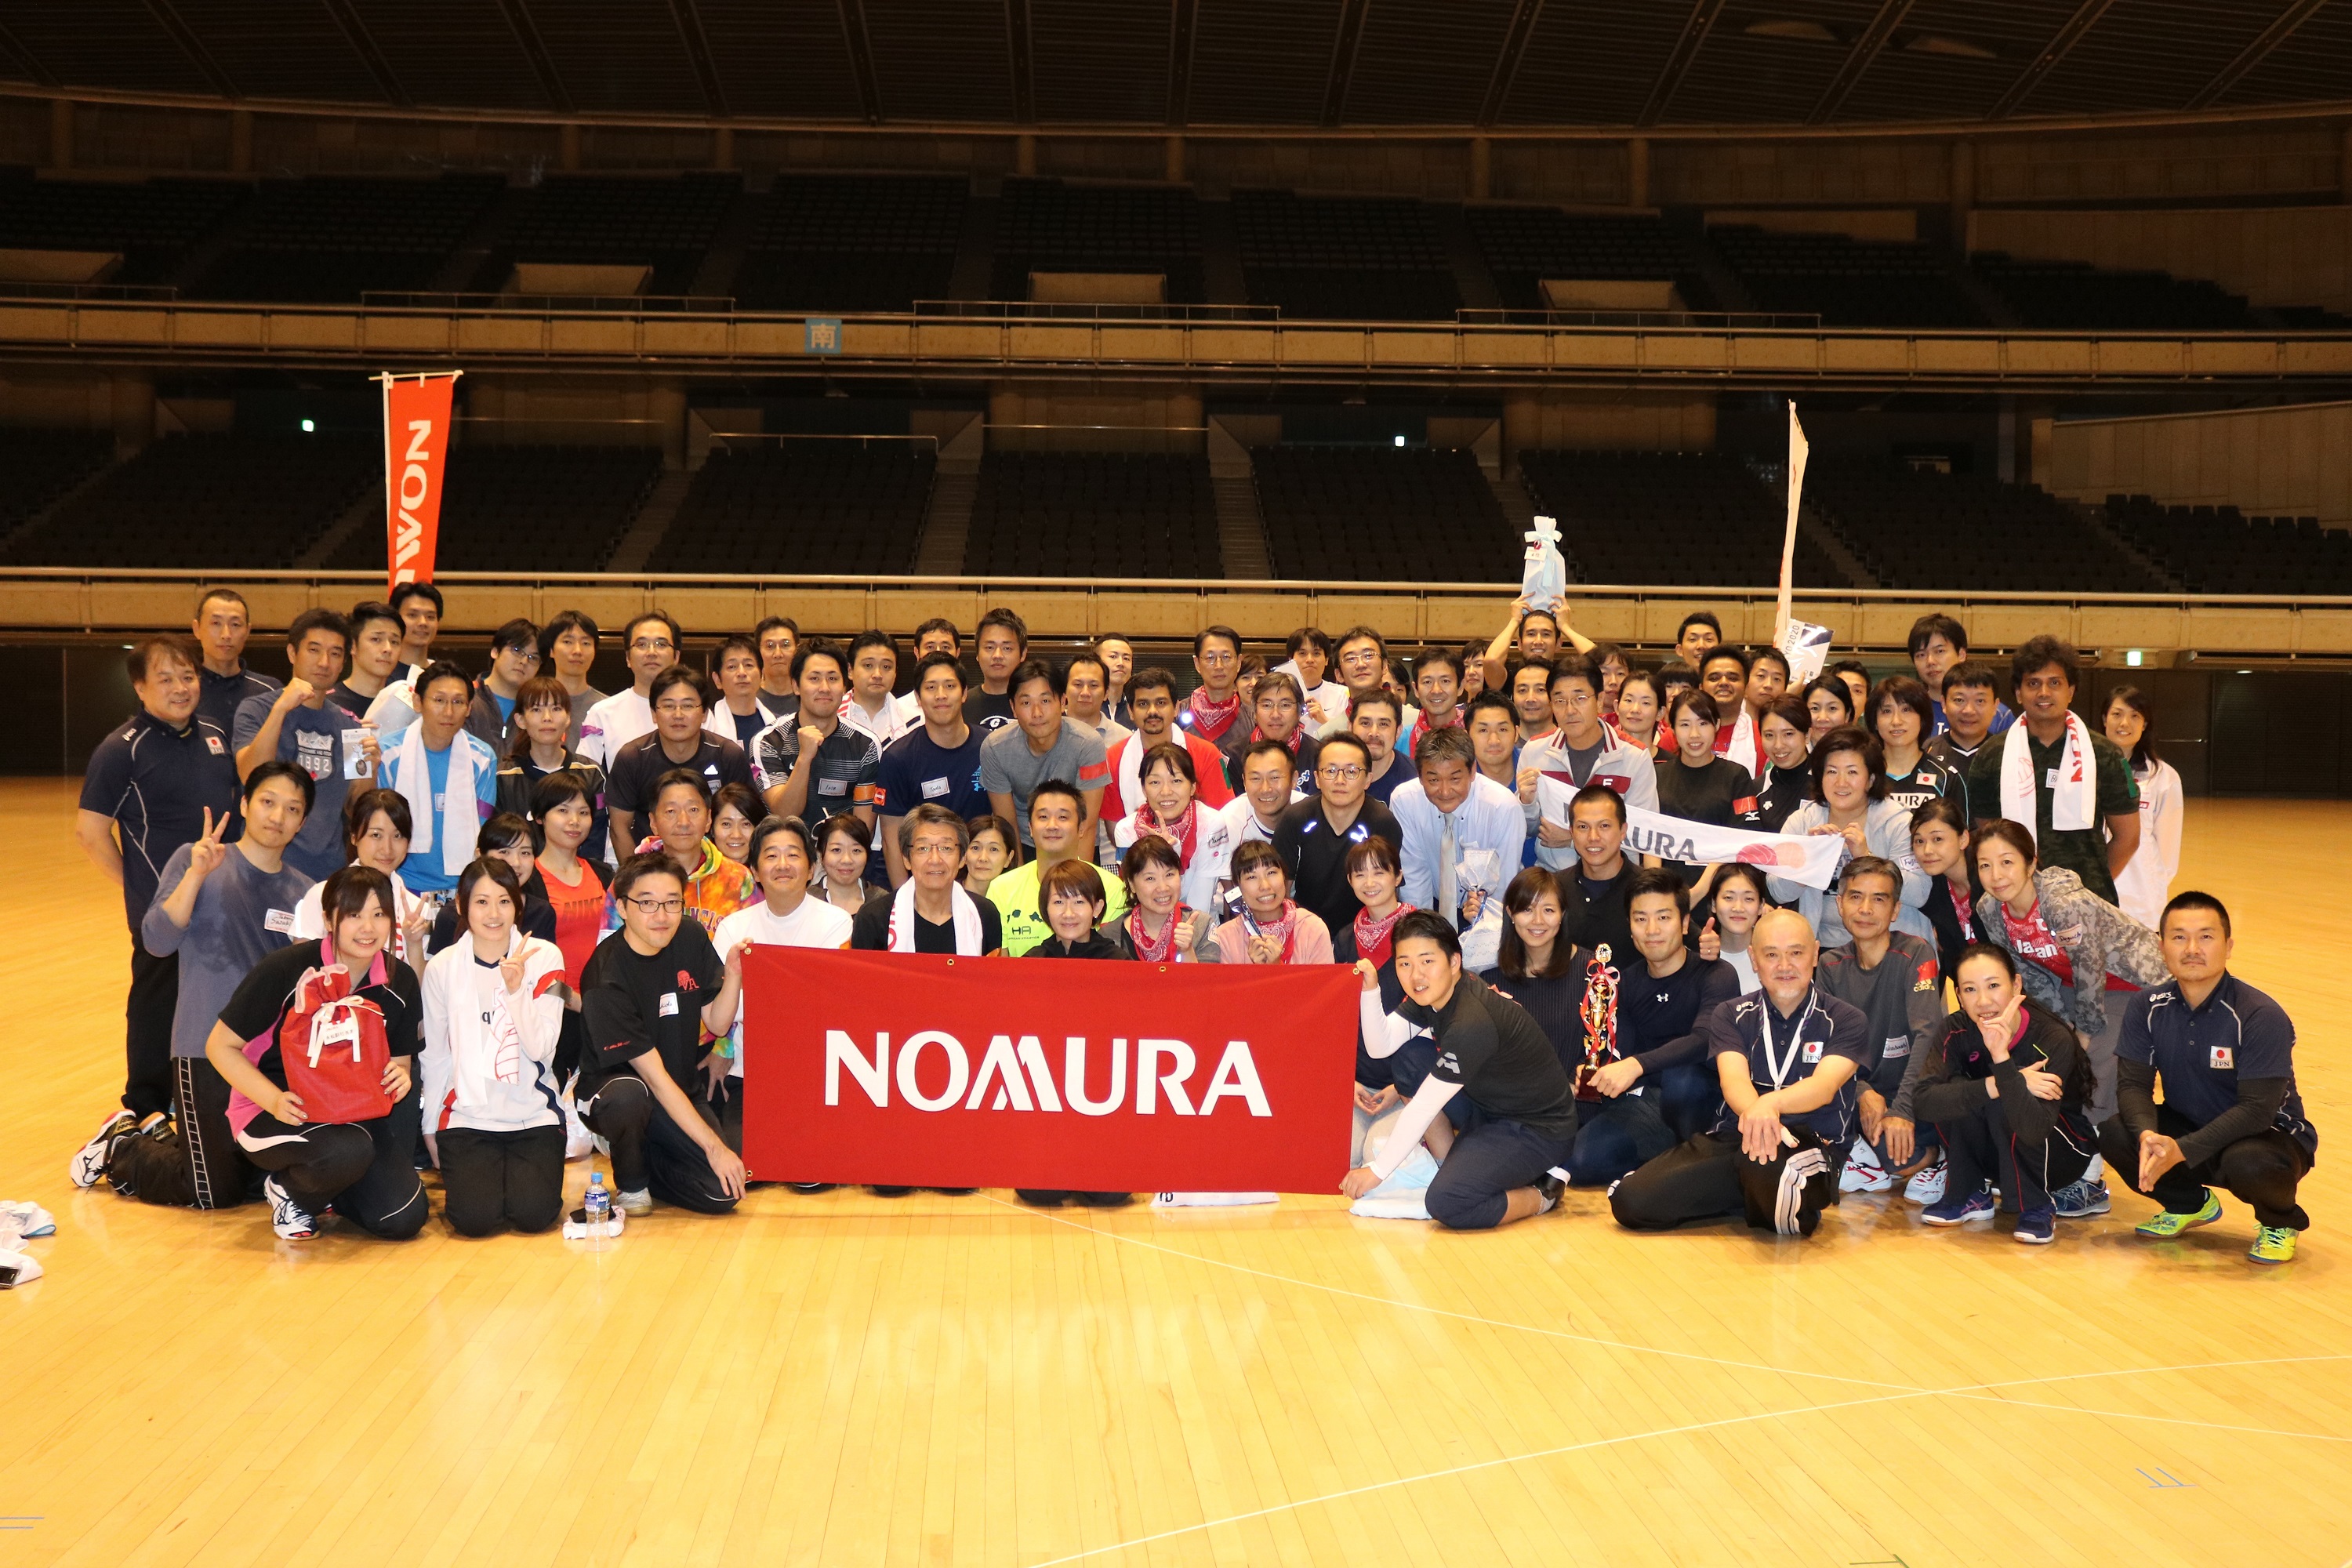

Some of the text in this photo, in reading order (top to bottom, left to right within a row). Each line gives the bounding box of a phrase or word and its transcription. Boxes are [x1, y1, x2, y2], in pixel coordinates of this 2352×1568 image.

[810, 323, 837, 349] 南
[299, 754, 330, 772] 1892
[562, 895, 604, 924] NIKE
[1012, 926, 1032, 935] HA
[824, 1029, 1273, 1118] NOMURA
